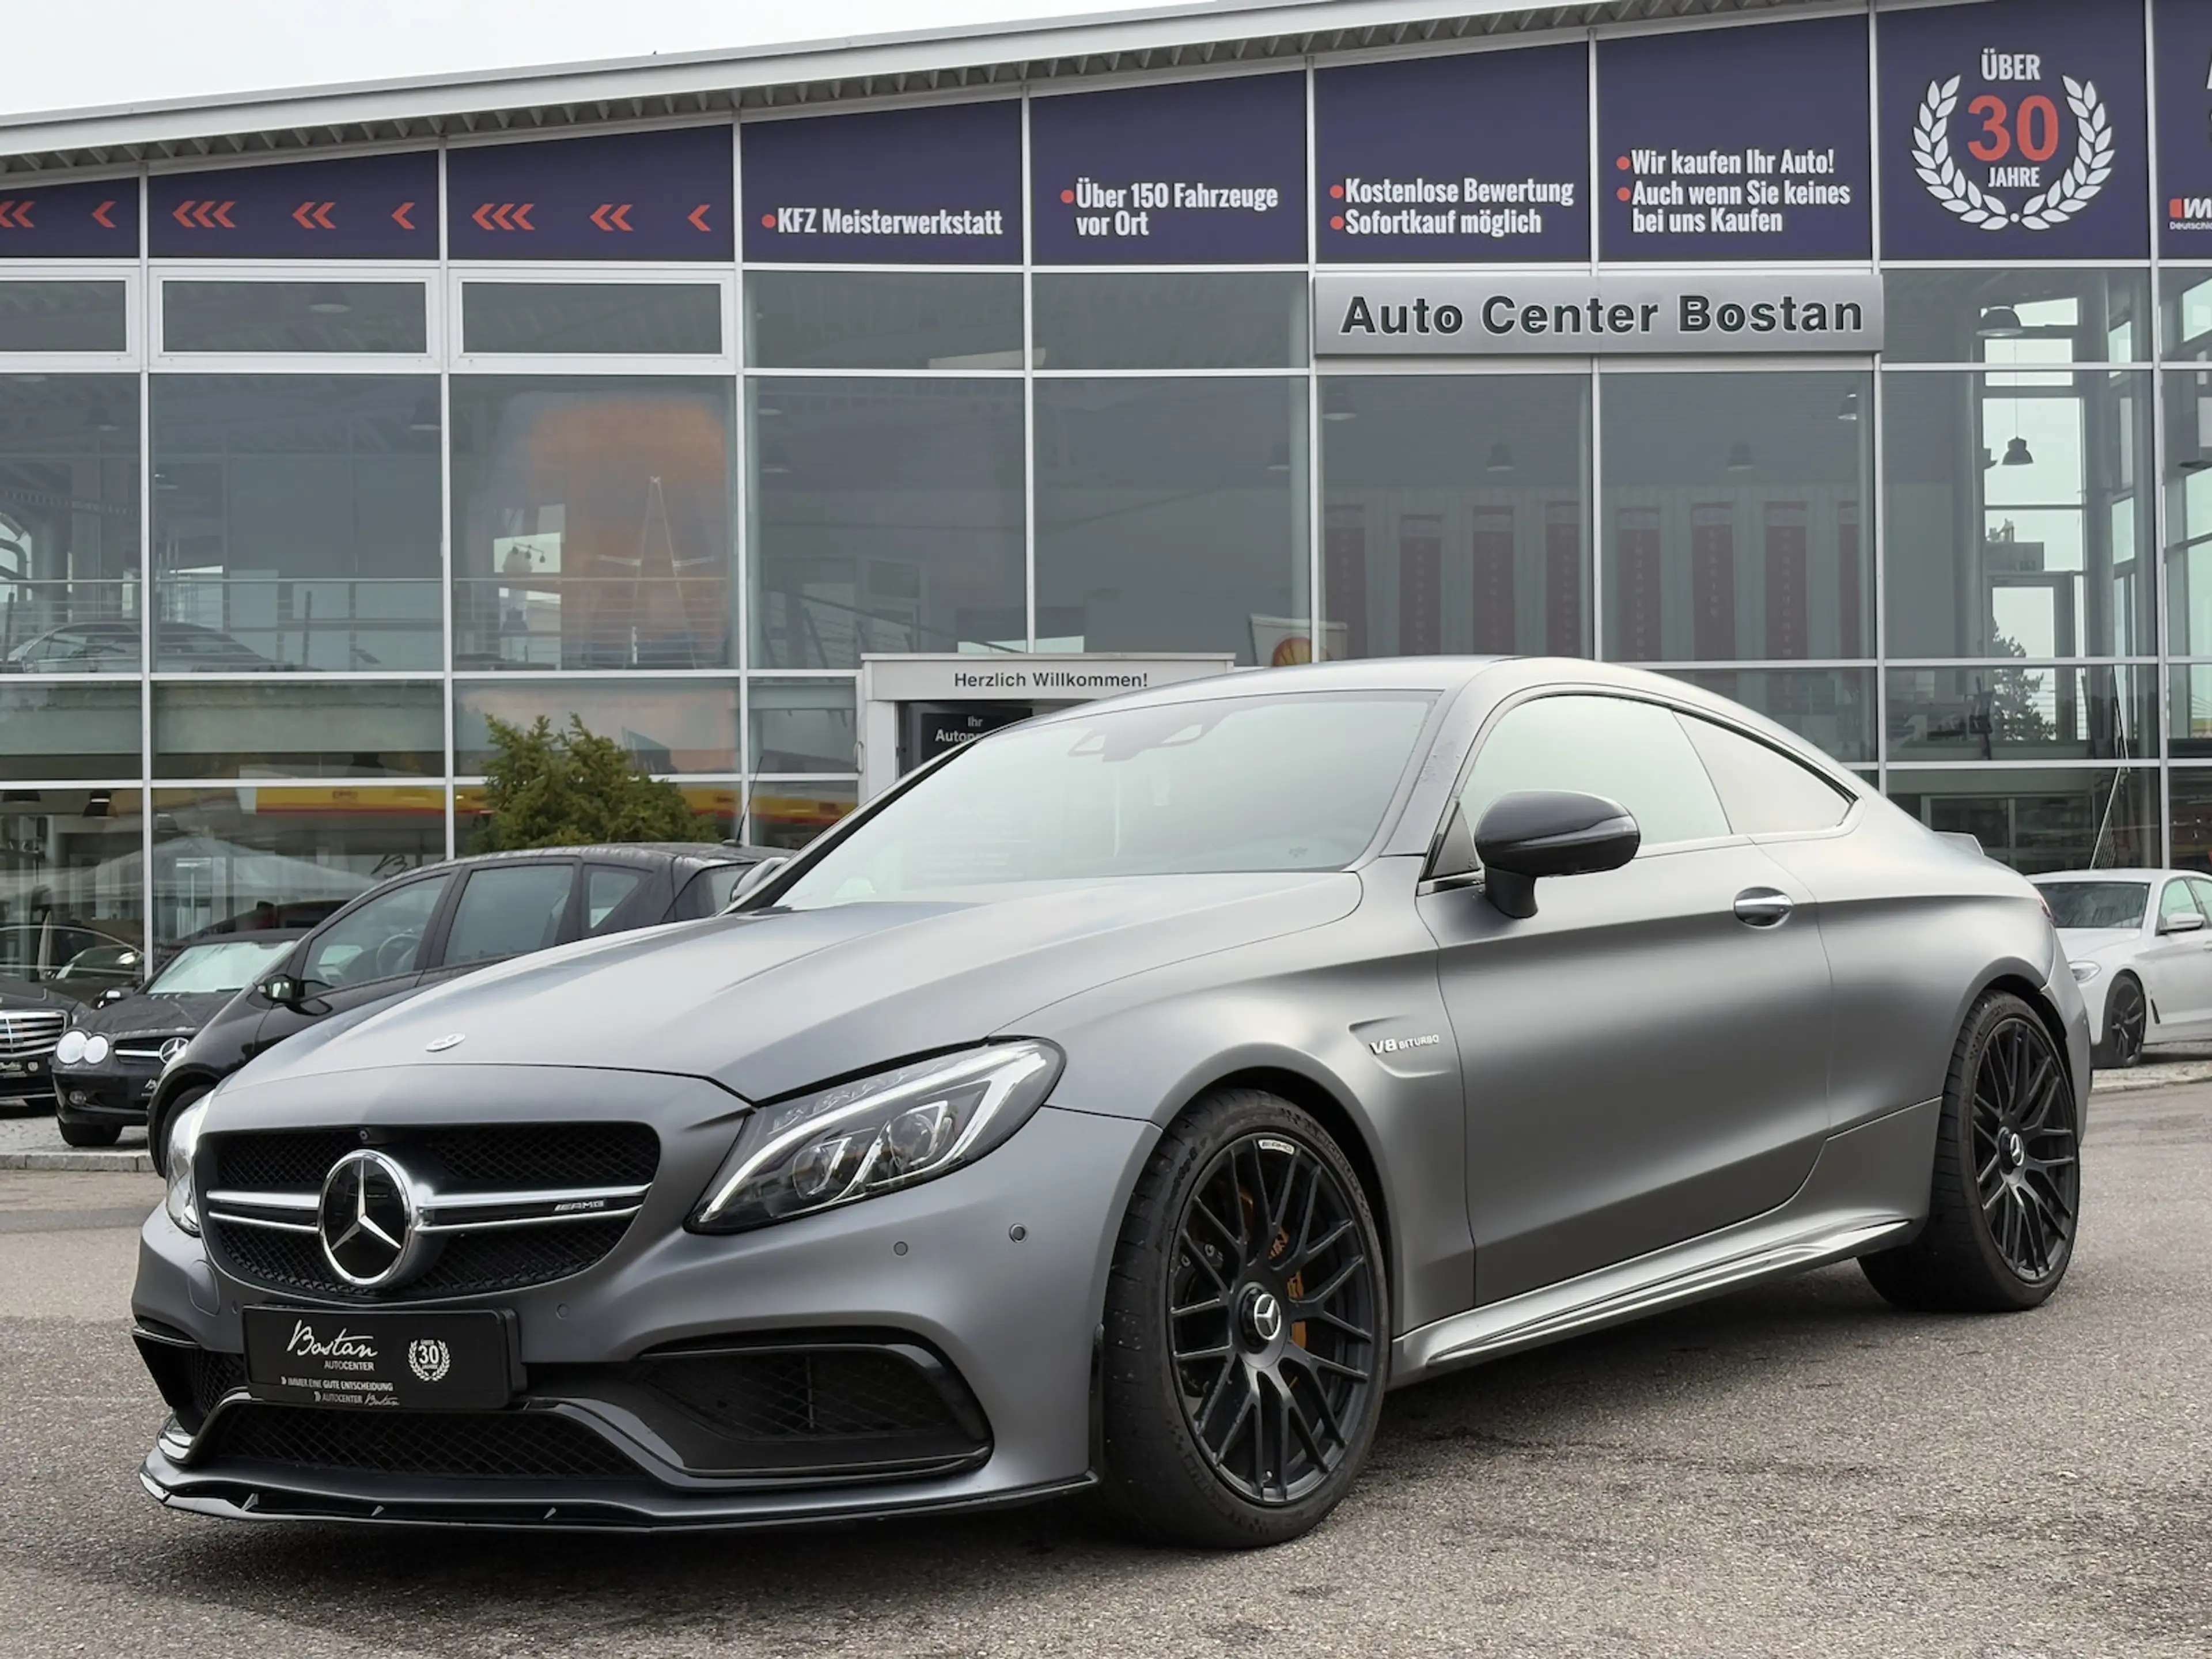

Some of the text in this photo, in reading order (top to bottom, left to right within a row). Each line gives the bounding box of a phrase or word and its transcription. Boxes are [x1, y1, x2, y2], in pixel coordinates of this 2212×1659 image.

[1981, 47, 2041, 81] ÜBER
[1967, 94, 2059, 162] 30
[1631, 149, 1835, 175] Wir kaufen Ihr Auto!
[1988, 166, 2041, 188] JAHRE
[1076, 177, 1279, 211] Über 150 Fahrzeuge
[1345, 177, 1575, 206] Kostenlose Bewertung
[1631, 179, 1851, 206] Auch wenn Sie keines
[778, 207, 1003, 235] KFZ Meisterwerkstatt
[1075, 210, 1150, 236] vor Ort
[1344, 208, 1542, 237] Sofortkauf möglich
[1632, 206, 1783, 233] bei uns Kaufen
[1340, 295, 1862, 335] Auto Center Bostan
[954, 672, 1148, 688] Herzlich Willkommen!
[967, 715, 983, 727] Ihr
[1369, 1038, 1397, 1055] V8
[286, 1319, 378, 1358] Bostan
[324, 1360, 375, 1372] AUTOCENTER
[418, 1344, 440, 1364] 30
[323, 1380, 340, 1389] GUTE
[322, 1393, 363, 1404] AUTOCENTER
